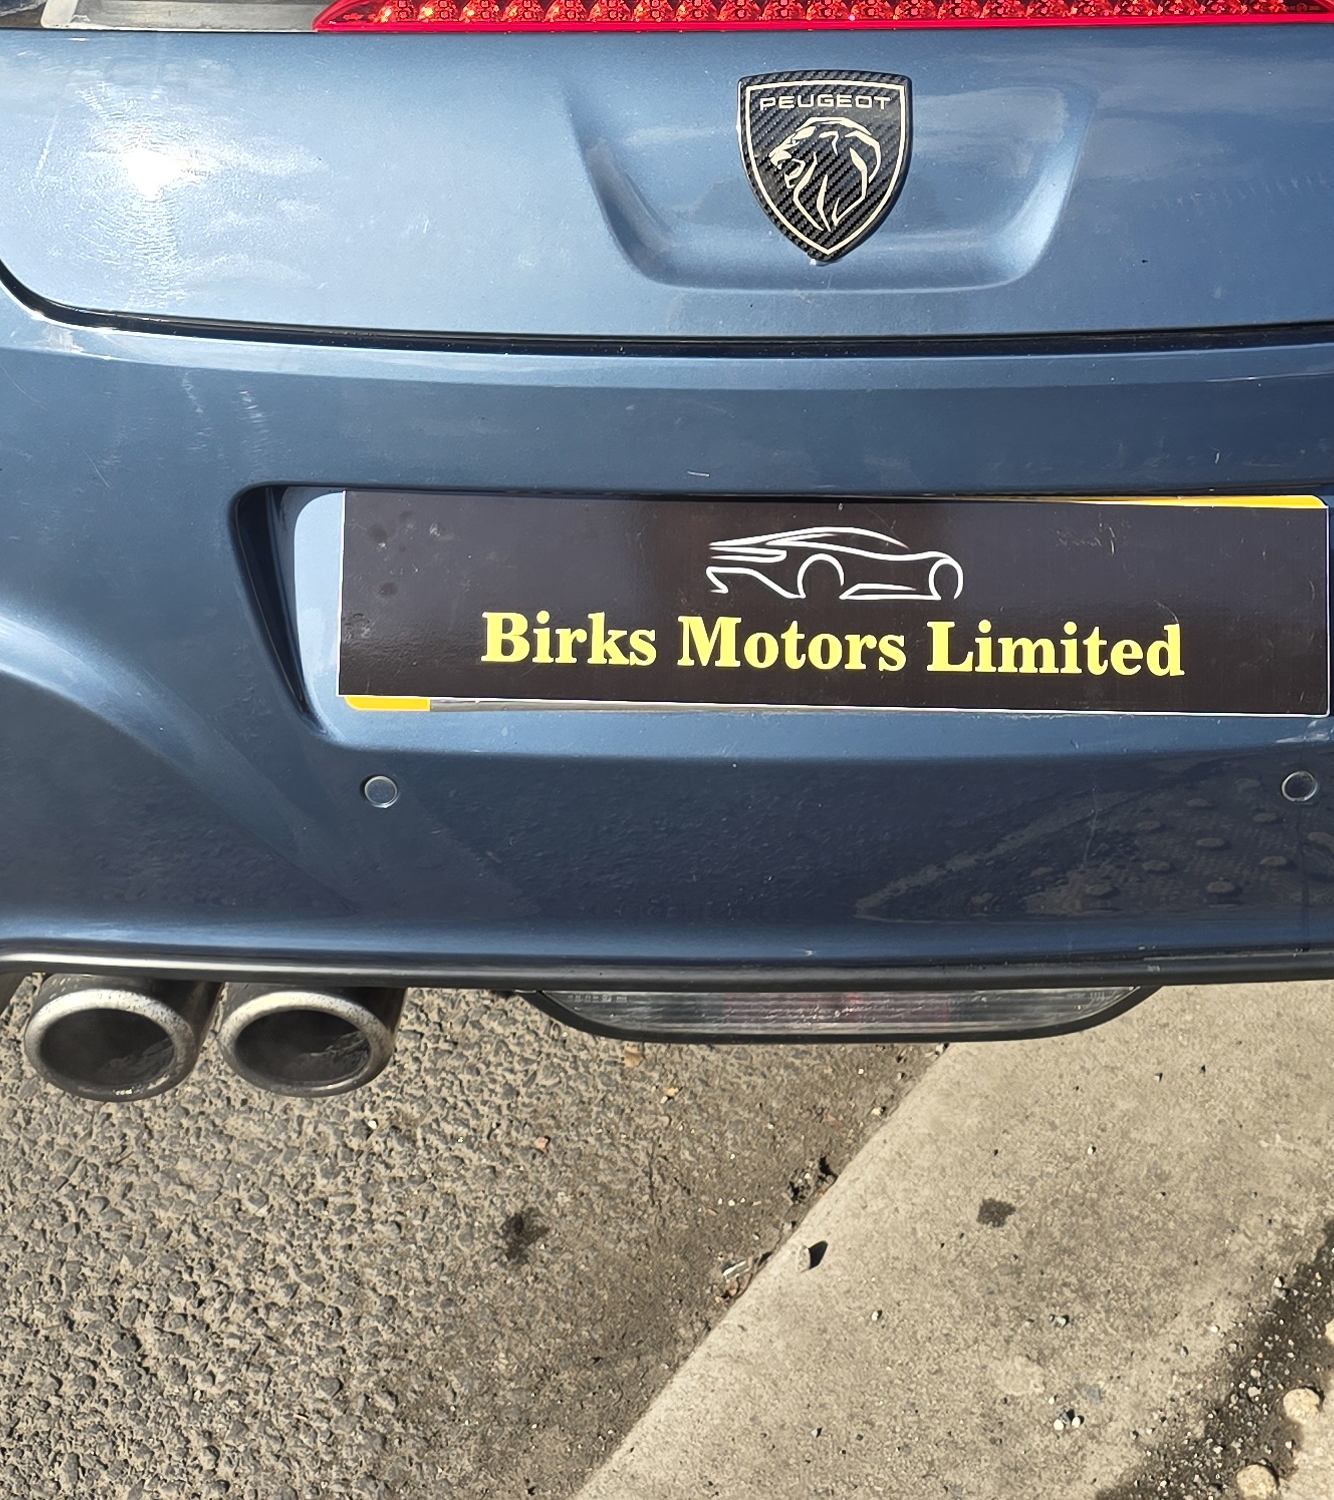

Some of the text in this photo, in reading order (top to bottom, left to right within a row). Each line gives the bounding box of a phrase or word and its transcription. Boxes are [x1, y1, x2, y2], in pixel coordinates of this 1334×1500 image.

[759, 94, 891, 111] PEUGEOT
[484, 612, 1183, 676] Birks Motors Limited
